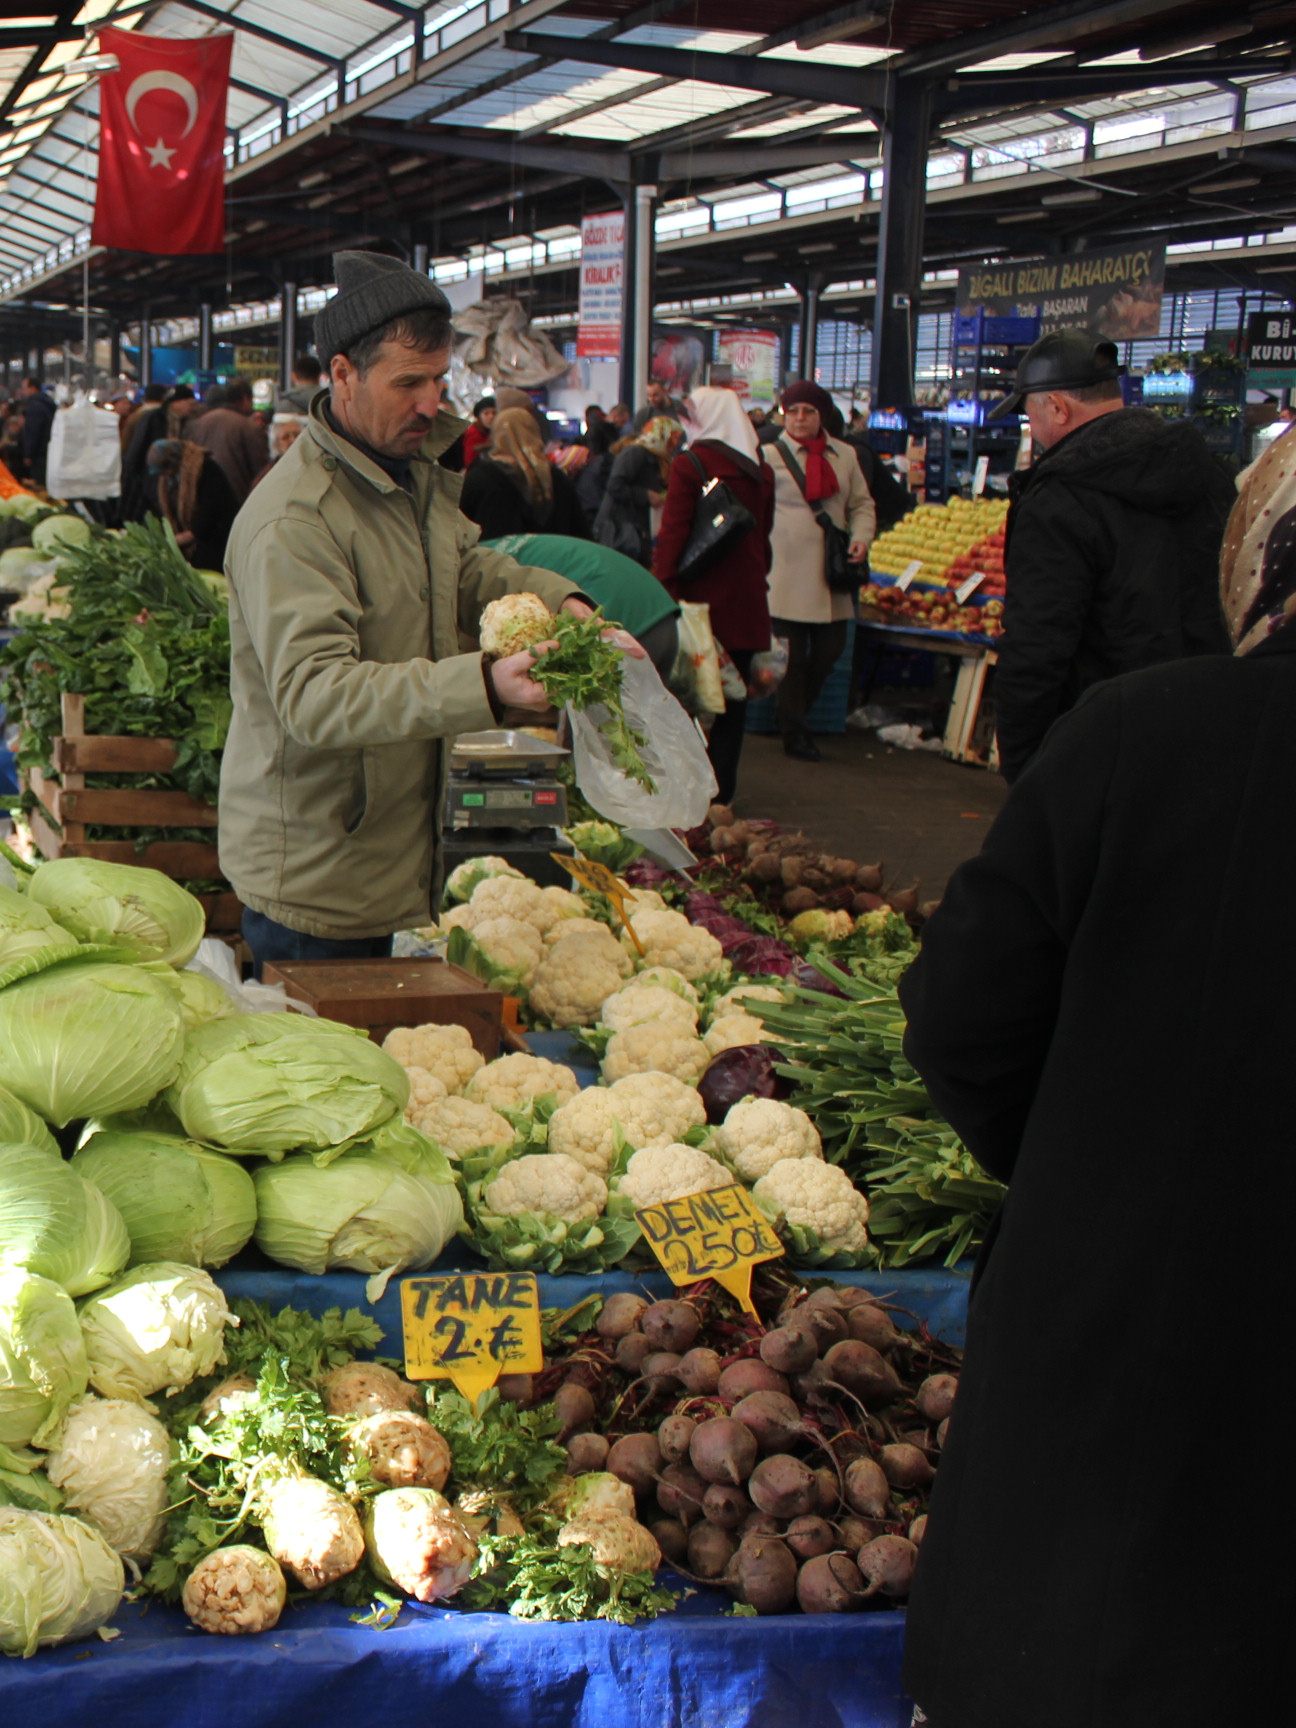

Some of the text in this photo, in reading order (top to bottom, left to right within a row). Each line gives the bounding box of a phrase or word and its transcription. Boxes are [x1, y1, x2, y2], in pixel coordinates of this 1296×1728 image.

[1017, 262, 1058, 295] BİZİM
[1042, 295, 1089, 321] BAŞARAN
[409, 1273, 536, 1321] TANE
